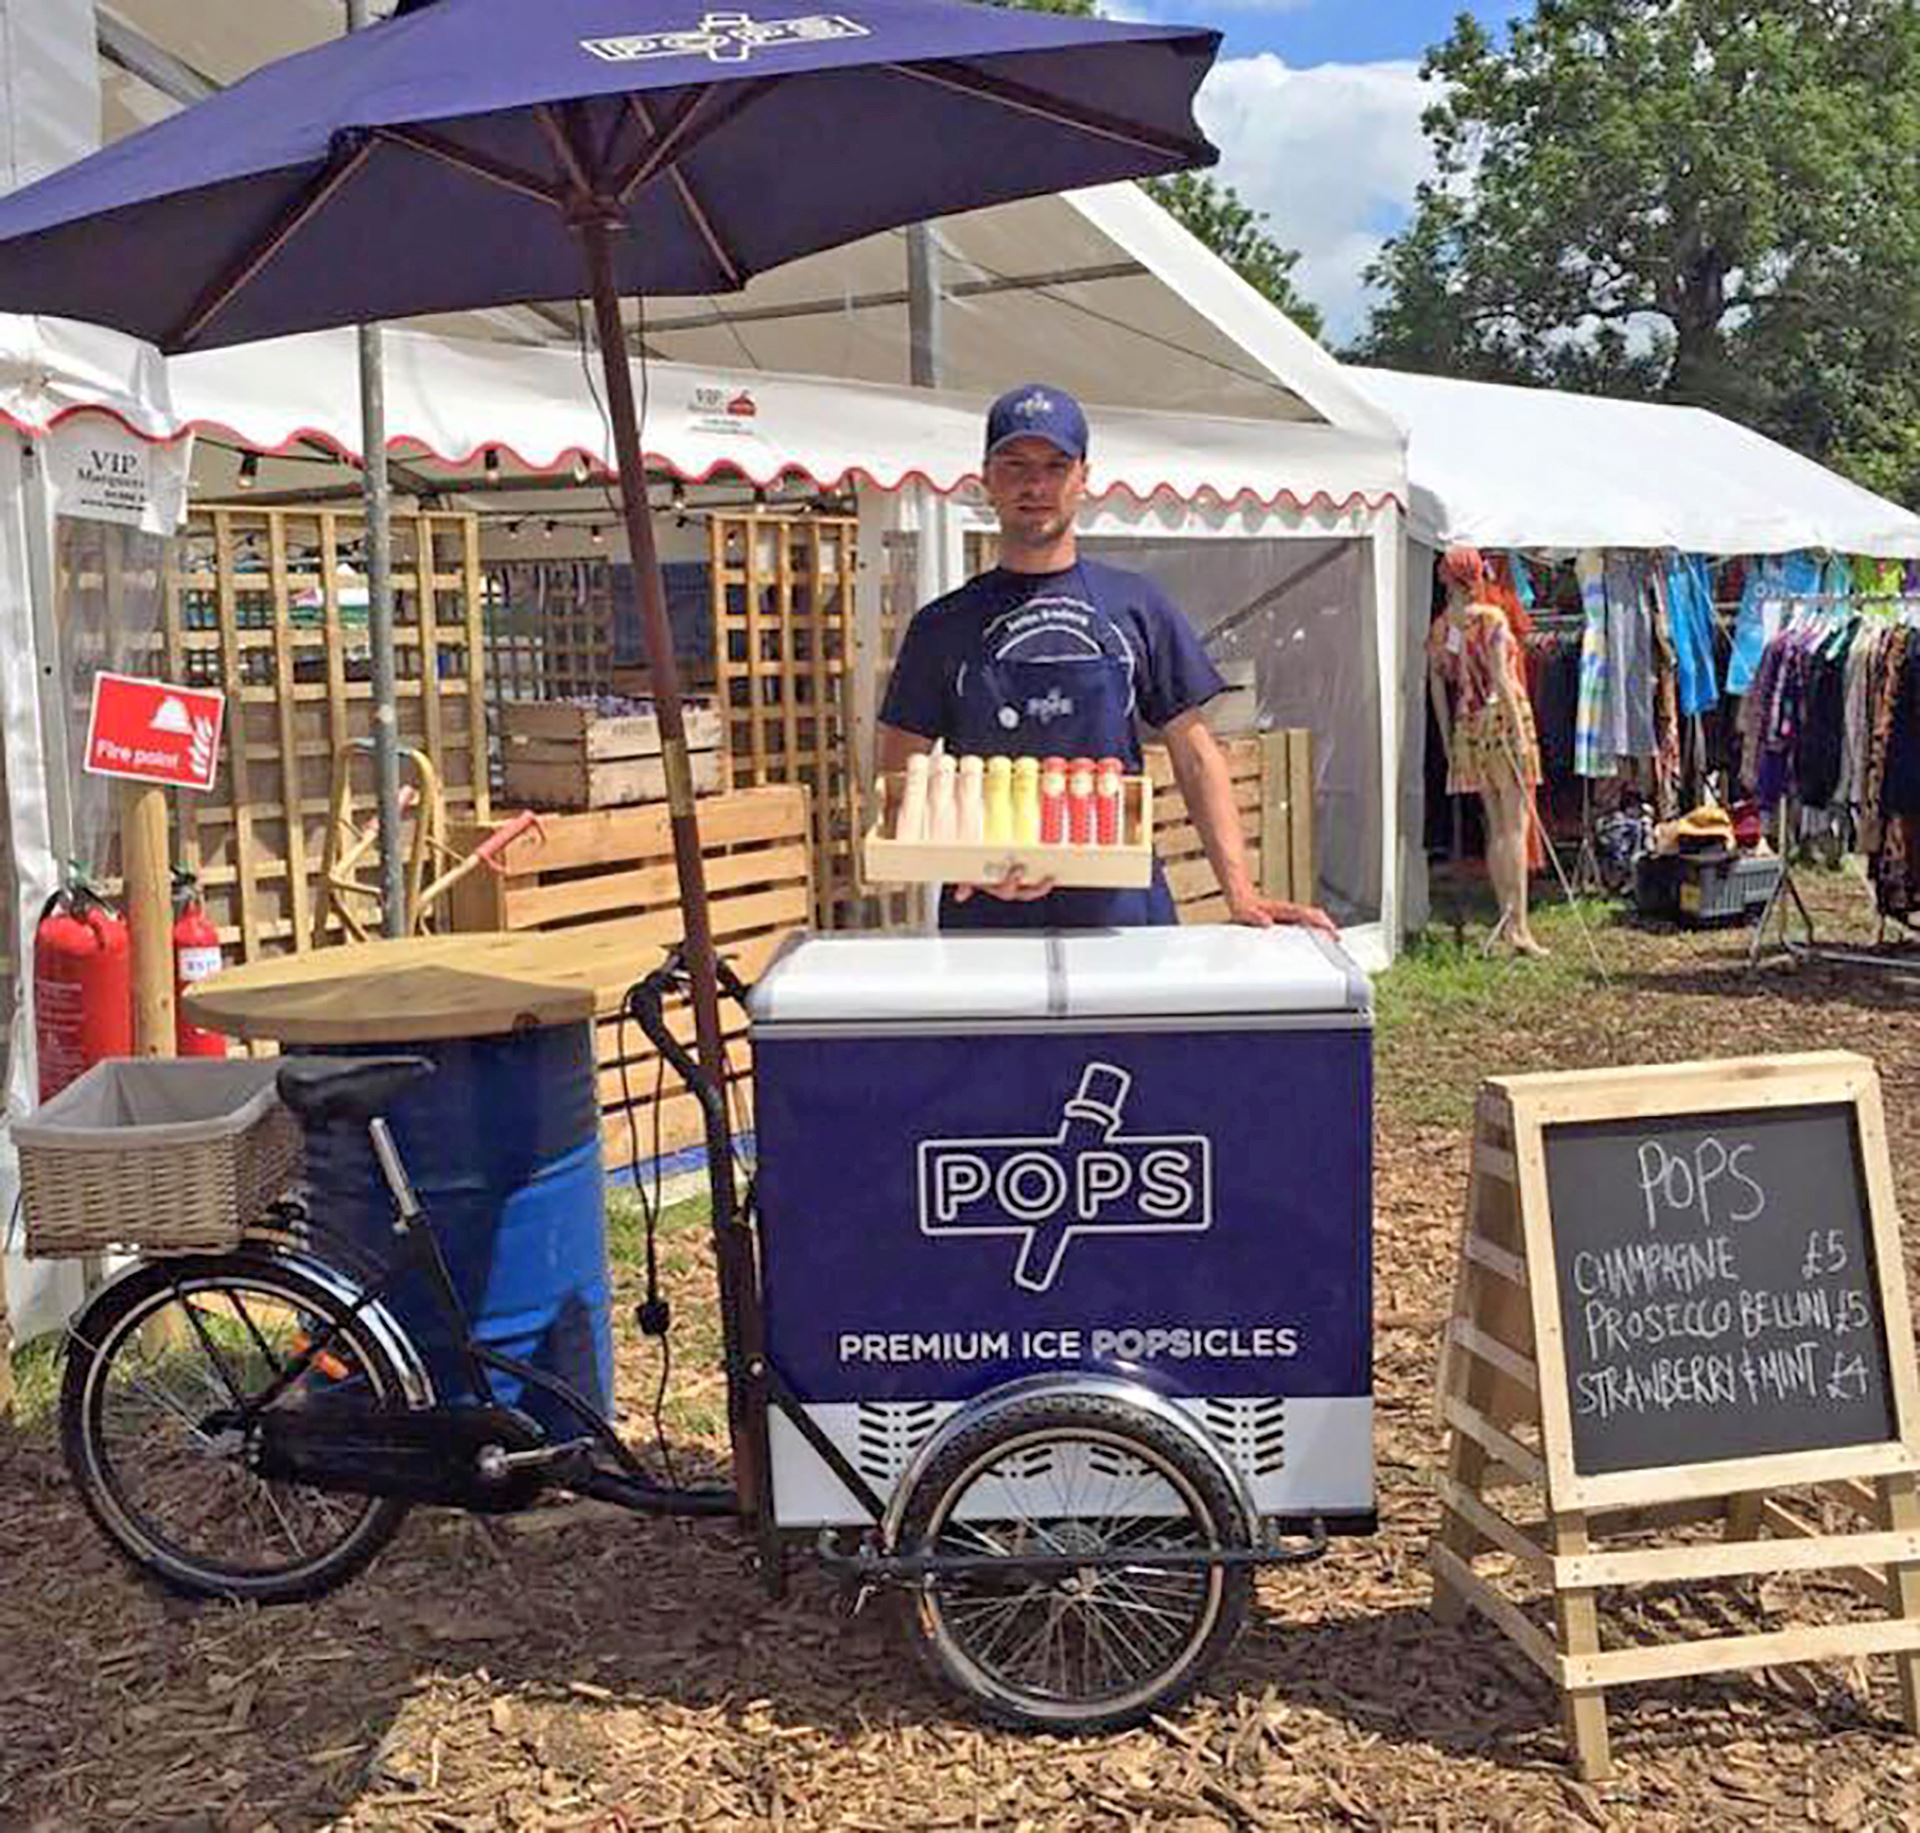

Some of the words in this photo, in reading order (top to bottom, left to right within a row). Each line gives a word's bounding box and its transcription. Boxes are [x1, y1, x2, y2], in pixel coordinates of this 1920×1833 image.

[91, 450, 137, 474] VIP
[97, 738, 132, 764] Fire
[133, 748, 180, 770] point
[935, 1150, 1195, 1222] POPS
[1637, 1136, 1766, 1230] POPS
[1801, 1229, 1848, 1279] £5
[838, 1332, 1010, 1363] PREMIUM
[1022, 1330, 1082, 1359] ICE
[1091, 1327, 1299, 1360] POPSICLES
[1584, 1299, 1731, 1361] PROSECCO
[1833, 1290, 1870, 1336] £5
[1577, 1354, 1736, 1418] STRAWBERRY
[1825, 1350, 1870, 1400] £4
